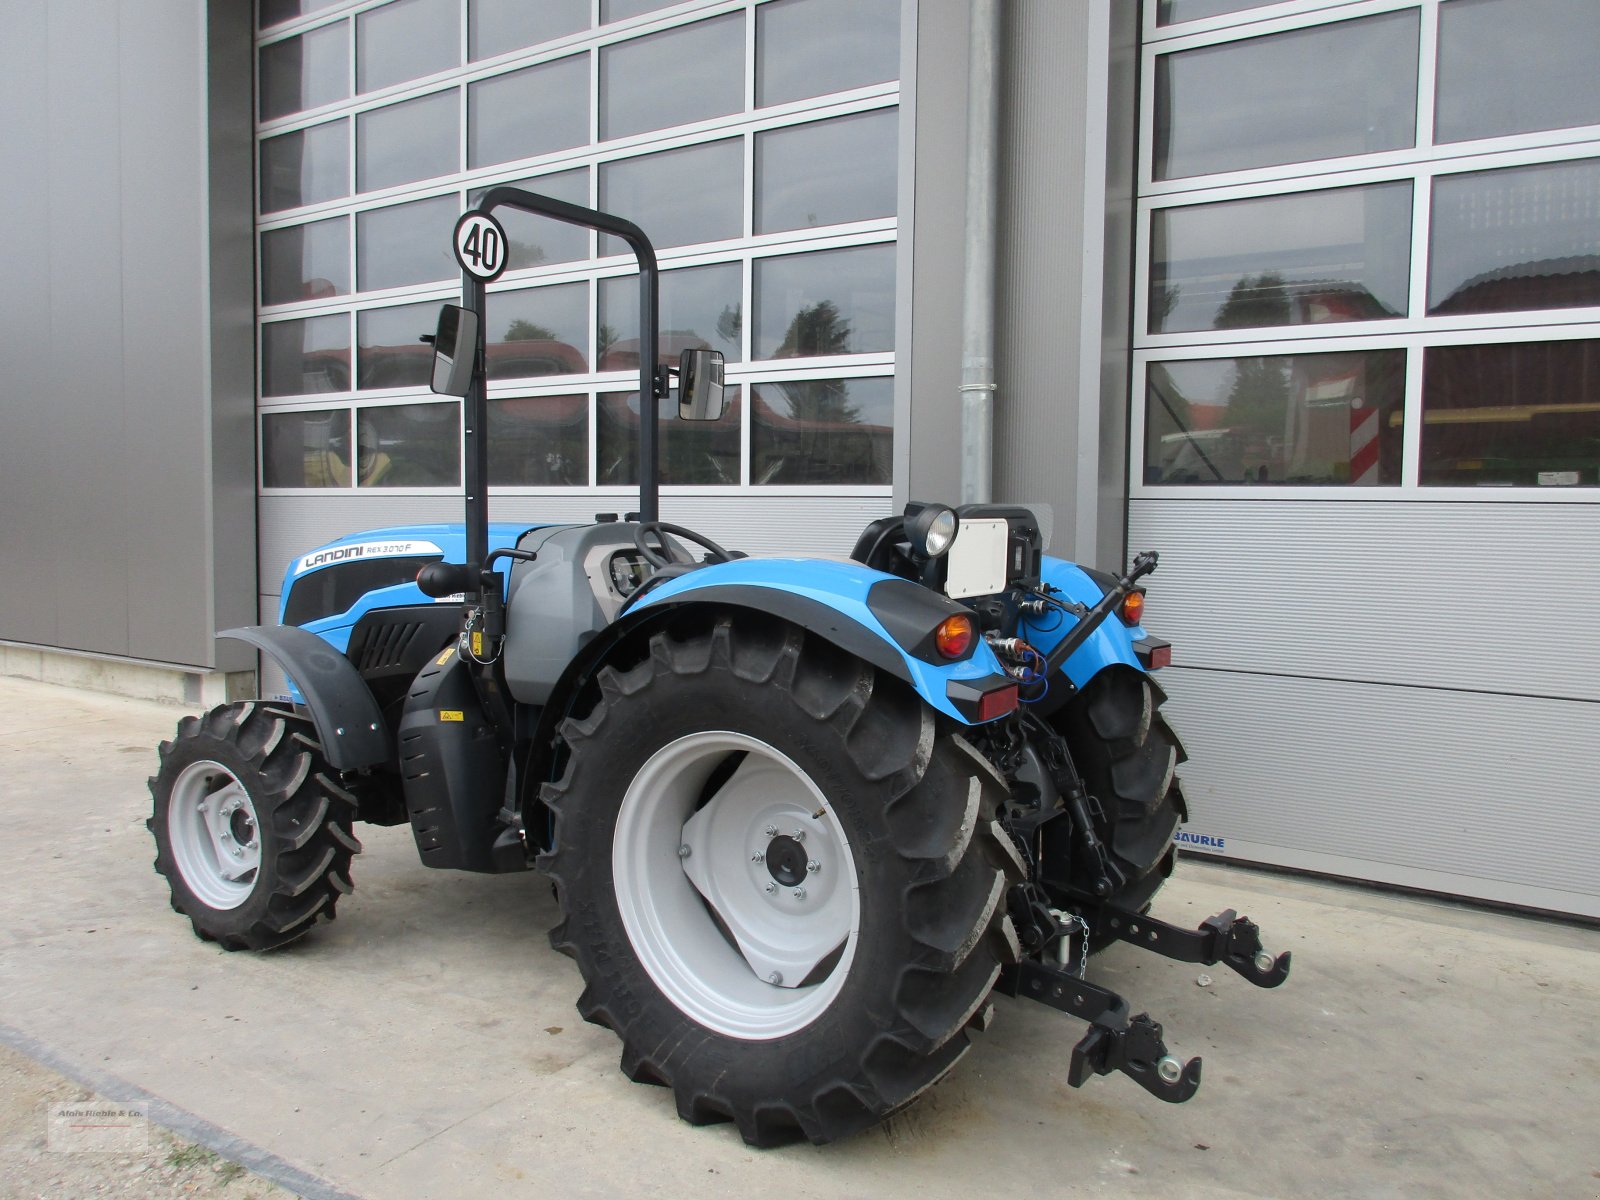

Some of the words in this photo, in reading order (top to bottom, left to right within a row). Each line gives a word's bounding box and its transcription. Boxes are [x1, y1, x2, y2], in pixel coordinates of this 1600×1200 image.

[463, 223, 498, 271] 40
[305, 546, 364, 567] LANDINI
[367, 545, 383, 554] REX
